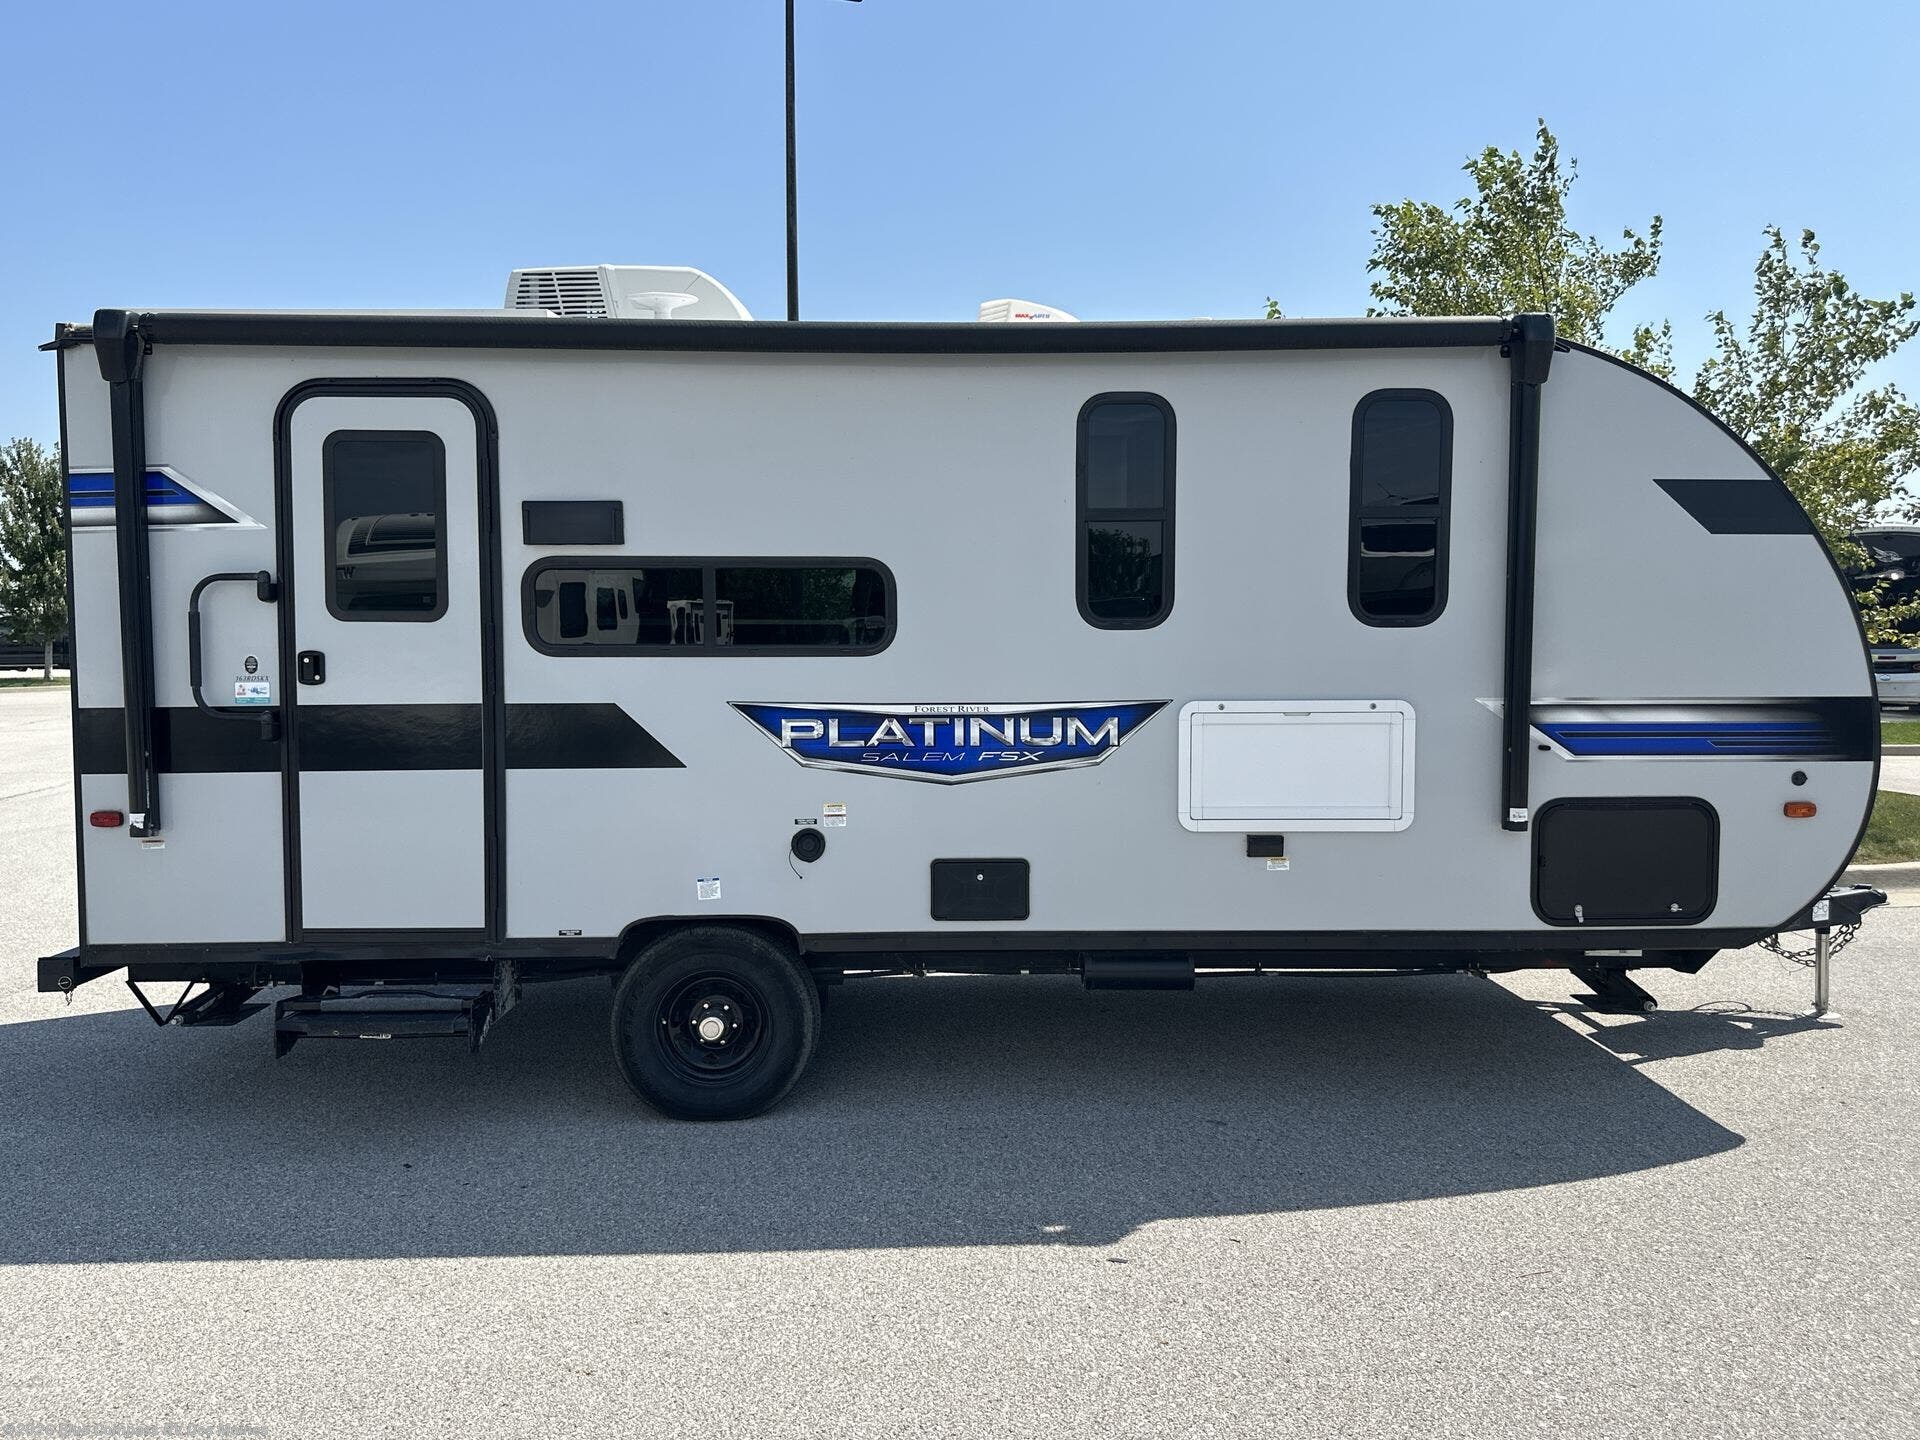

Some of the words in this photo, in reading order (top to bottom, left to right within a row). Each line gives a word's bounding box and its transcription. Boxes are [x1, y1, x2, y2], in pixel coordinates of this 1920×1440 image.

[914, 704, 956, 713] FOREST
[958, 704, 990, 713] RIVER
[781, 716, 1121, 748] PLATINUM
[861, 751, 966, 762] SALEM
[978, 751, 1045, 762] FSX
